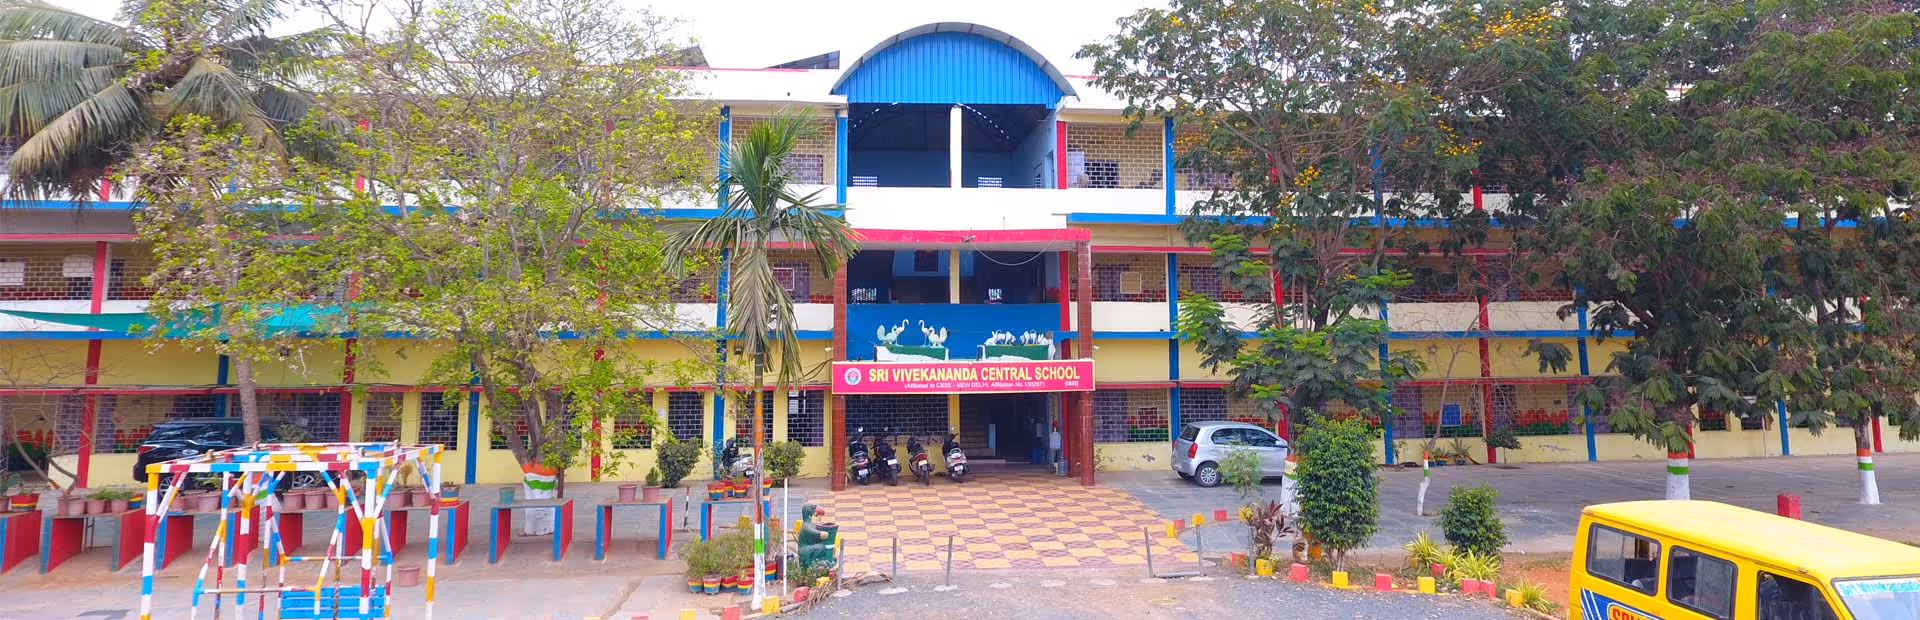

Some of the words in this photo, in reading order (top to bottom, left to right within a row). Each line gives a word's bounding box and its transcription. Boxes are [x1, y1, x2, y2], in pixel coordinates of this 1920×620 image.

[868, 368, 889, 382] SRI
[892, 367, 978, 382] VIVEKANANDA
[981, 367, 1033, 381] CENTRAL
[1034, 366, 1080, 380] SCHOOL
